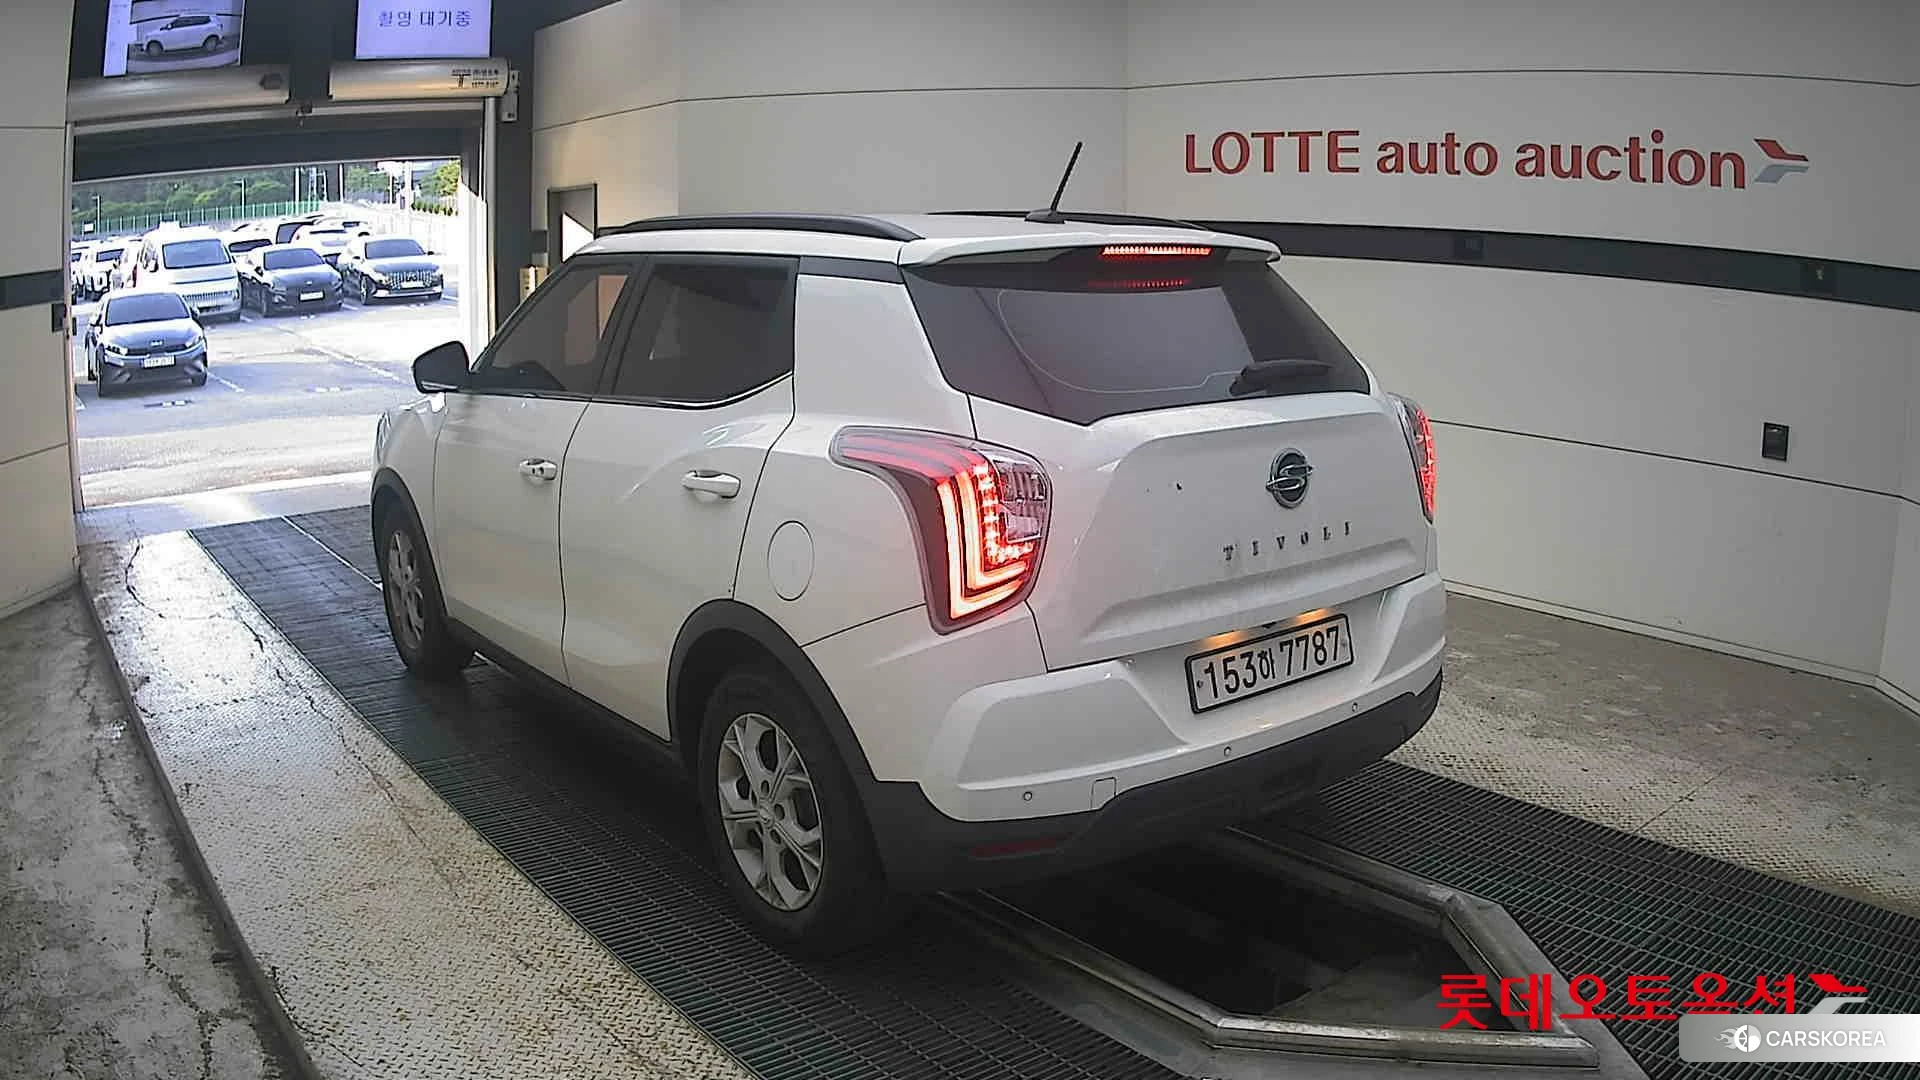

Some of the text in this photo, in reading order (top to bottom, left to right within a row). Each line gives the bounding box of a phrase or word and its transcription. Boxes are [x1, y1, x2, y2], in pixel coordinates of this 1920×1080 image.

[420, 10, 473, 27] 대기중
[1185, 129, 1746, 189] LOTTE auto auction
[1223, 521, 1351, 561] TIVOLI
[1279, 624, 1340, 676] 7787
